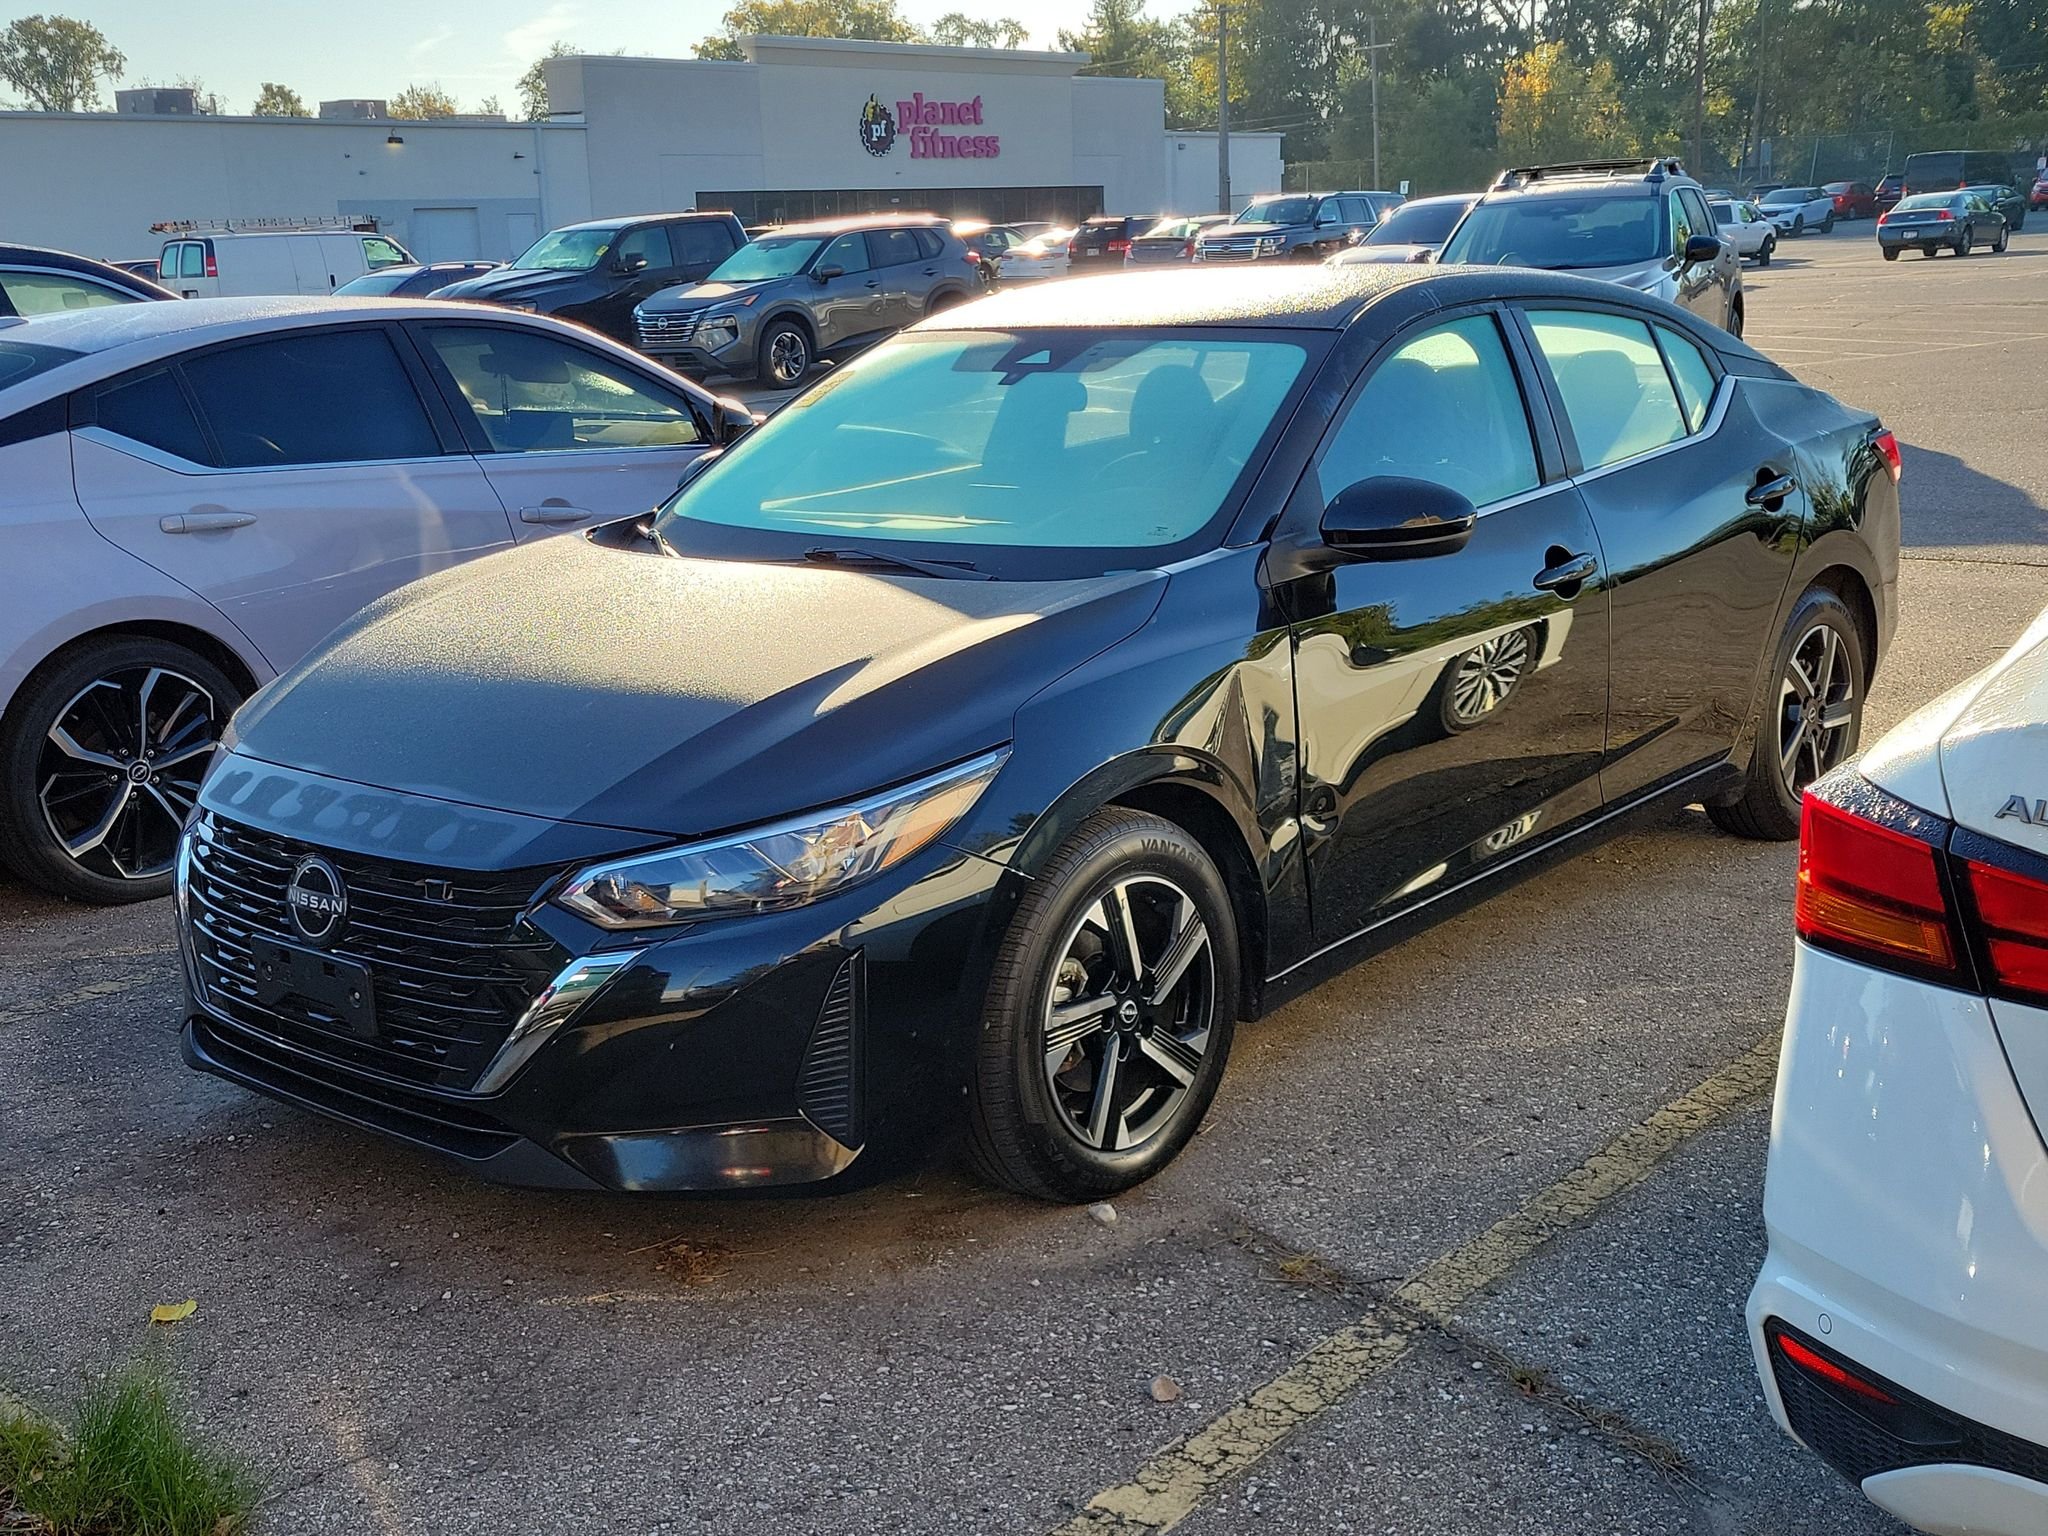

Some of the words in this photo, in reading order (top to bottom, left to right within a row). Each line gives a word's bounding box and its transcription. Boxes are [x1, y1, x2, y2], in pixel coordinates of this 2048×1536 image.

[896, 93, 983, 134] planet
[871, 120, 887, 141] pf
[910, 126, 1000, 158] fitness
[288, 887, 343, 913] NISSAN
